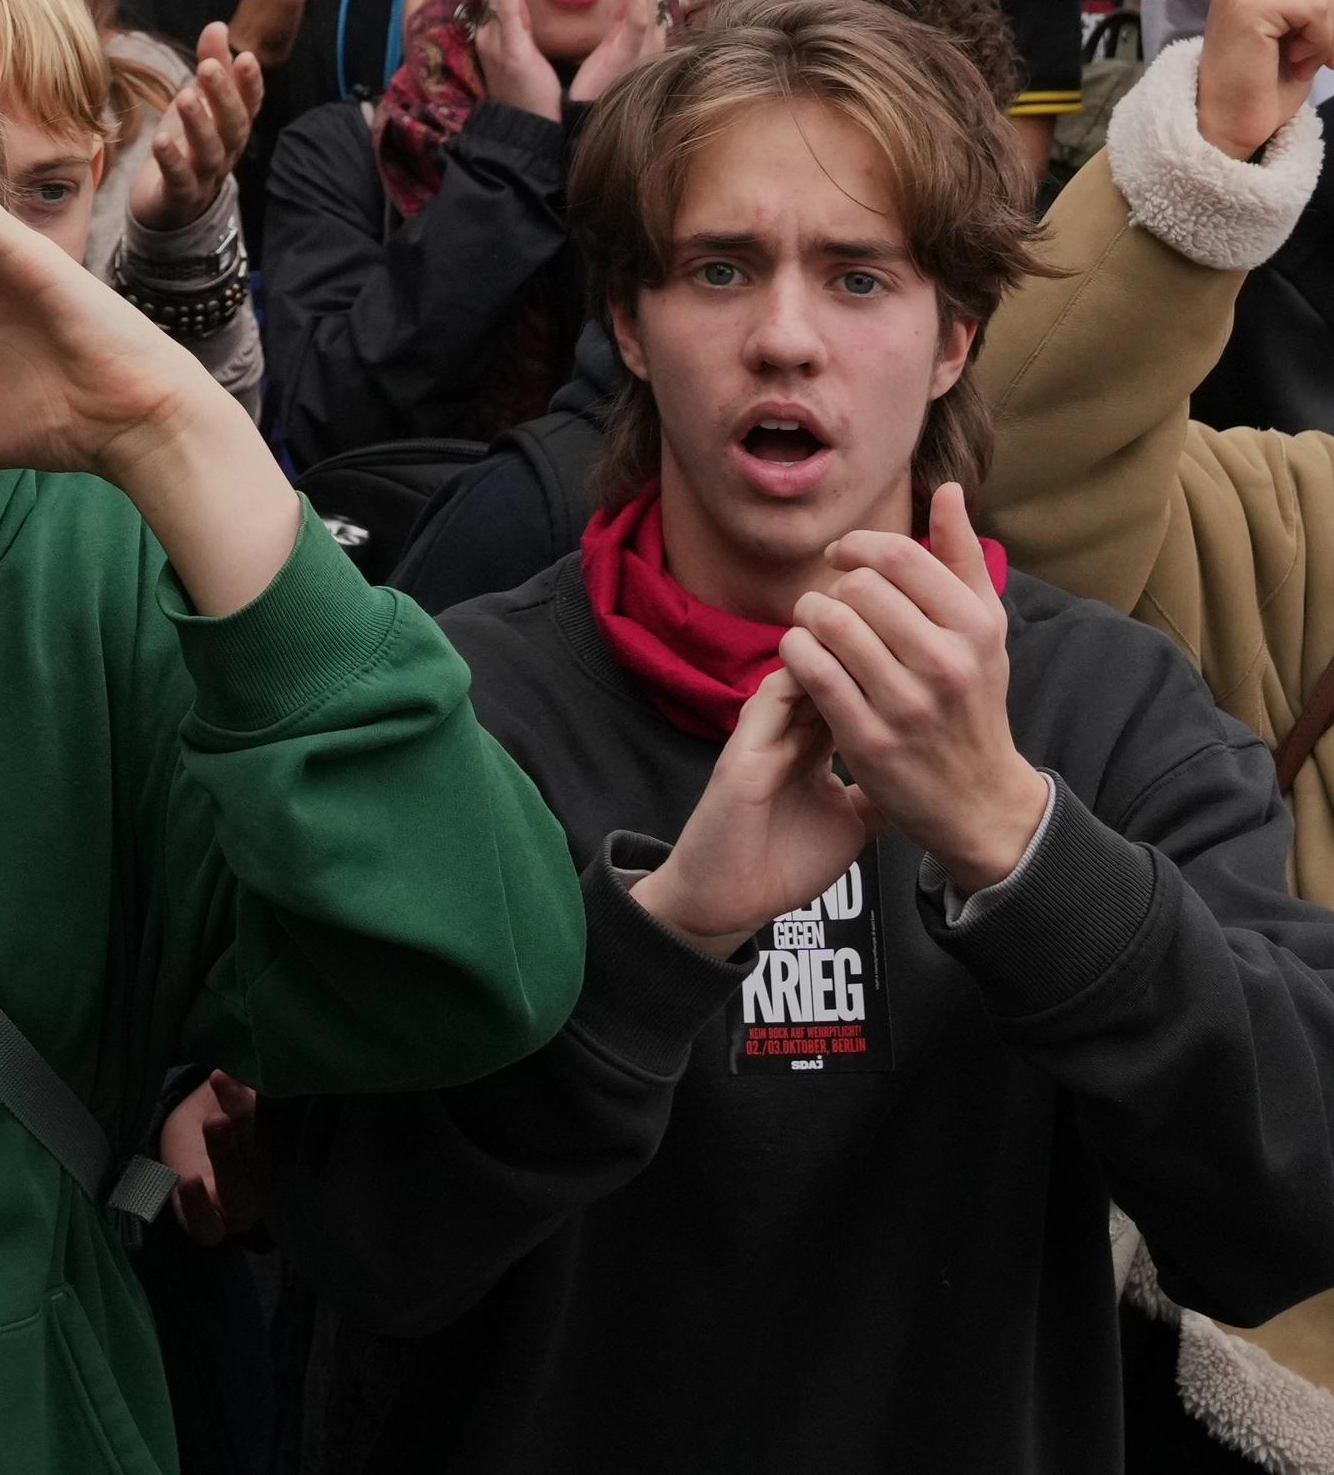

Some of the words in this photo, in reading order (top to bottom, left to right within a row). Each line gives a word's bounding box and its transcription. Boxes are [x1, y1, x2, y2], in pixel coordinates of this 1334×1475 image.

[773, 921, 825, 949] GEGEN
[742, 947, 866, 1024] KRIEG
[749, 1028, 767, 1039] KEIN
[768, 1027, 789, 1039] BOCK
[790, 1027, 805, 1038] AUF
[806, 1025, 862, 1038] WEHRPFLICHT!
[831, 1037, 866, 1053] BERLIN
